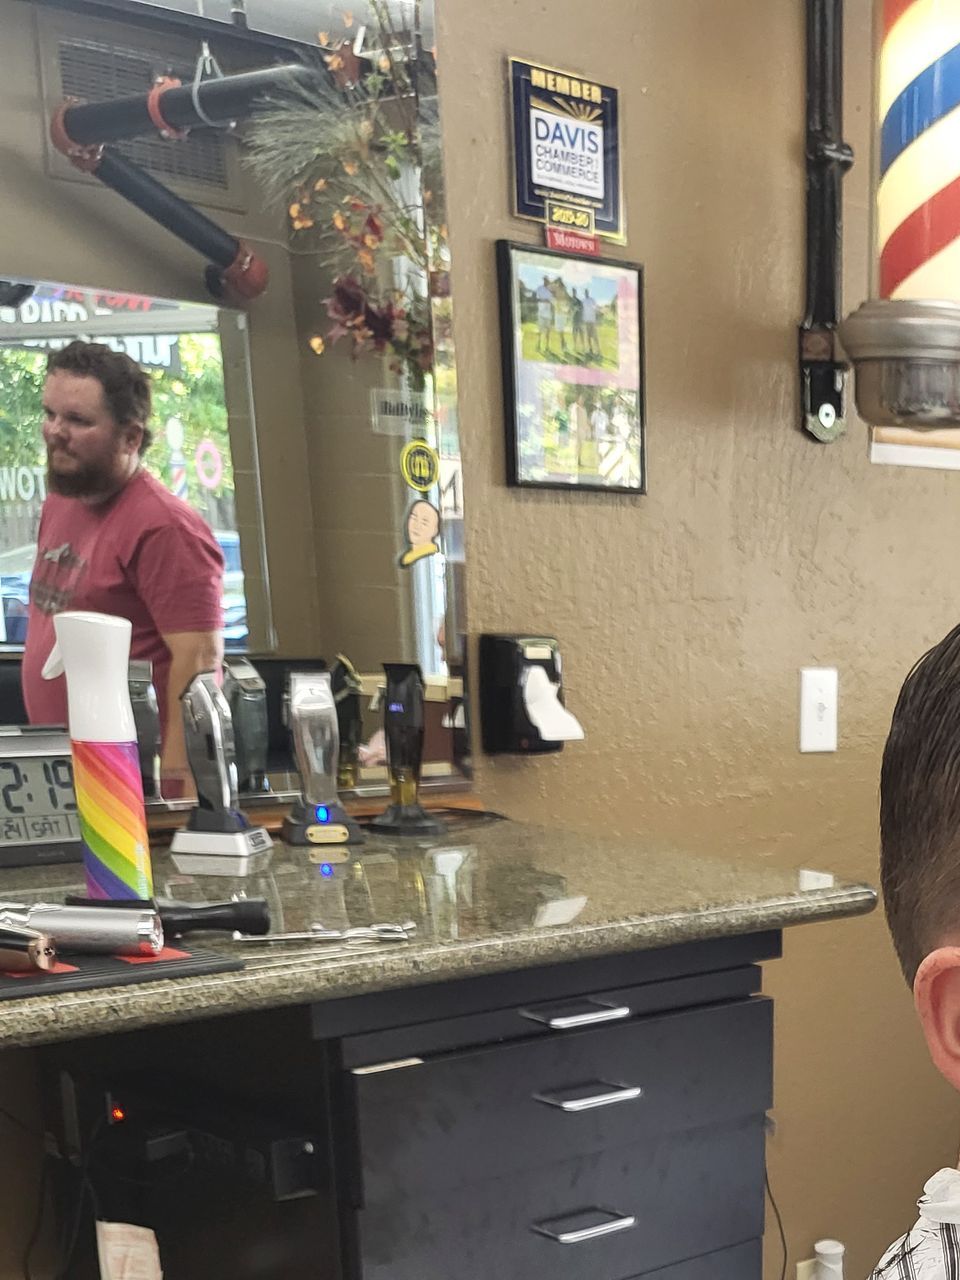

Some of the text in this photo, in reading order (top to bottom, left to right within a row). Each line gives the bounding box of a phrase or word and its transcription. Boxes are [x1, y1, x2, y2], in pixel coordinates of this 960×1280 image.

[530, 69, 602, 104] MEMBER
[535, 117, 599, 154] DAVIS
[536, 144, 594, 168] CHAMBER
[536, 158, 600, 184] COMMERCE
